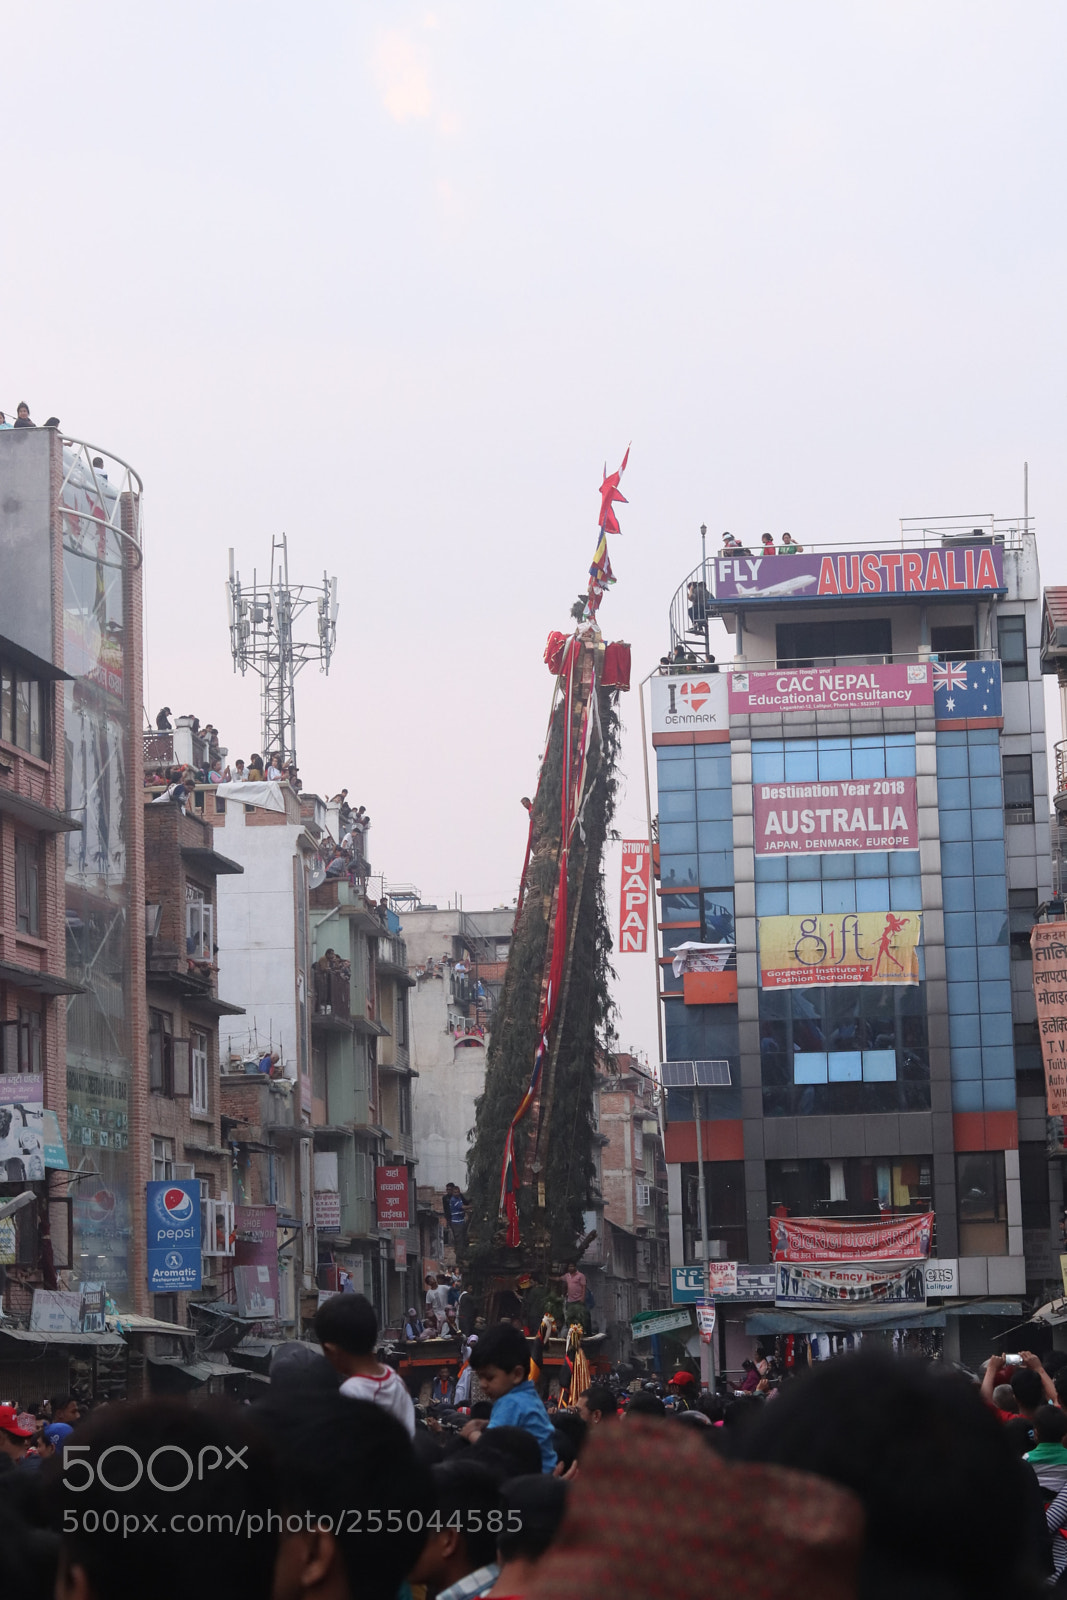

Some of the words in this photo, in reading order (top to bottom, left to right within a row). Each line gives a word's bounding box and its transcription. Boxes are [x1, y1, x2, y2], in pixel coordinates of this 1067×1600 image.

[719, 558, 763, 583] FLY
[817, 548, 999, 596] AUSTRALIA
[776, 676, 814, 693] CAC
[819, 673, 880, 690] NEPAL
[668, 684, 678, 714] I
[748, 691, 826, 706] Educational
[829, 689, 912, 703] Consultancy
[665, 714, 717, 724] DENMARK
[761, 784, 839, 800] Destination
[840, 783, 870, 796] Year
[873, 781, 905, 795] 2018
[764, 806, 909, 836] AUSTRALIA
[622, 842, 645, 854] STUDY
[764, 840, 802, 850] JAPAN,
[805, 838, 863, 849] DENMARK,
[866, 837, 909, 846] EUROPE
[621, 854, 648, 951] JAPAN
[794, 914, 874, 966] gift
[767, 968, 813, 978] Gorgeous
[815, 966, 858, 974] Institute
[776, 975, 813, 984] Fashion
[815, 973, 864, 982] Tecnology
[1048, 1074, 1064, 1086] Auto
[157, 1226, 194, 1242] pepsi
[788, 1227, 842, 1250] होलसेल
[844, 1231, 879, 1248] भन्दा
[882, 1223, 918, 1247] सस्तो
[152, 1268, 197, 1277] Aromatic
[710, 1263, 736, 1271] Riza's
[802, 1270, 826, 1278] R.K.
[830, 1270, 863, 1282] Fancy
[926, 1268, 954, 1282] ers
